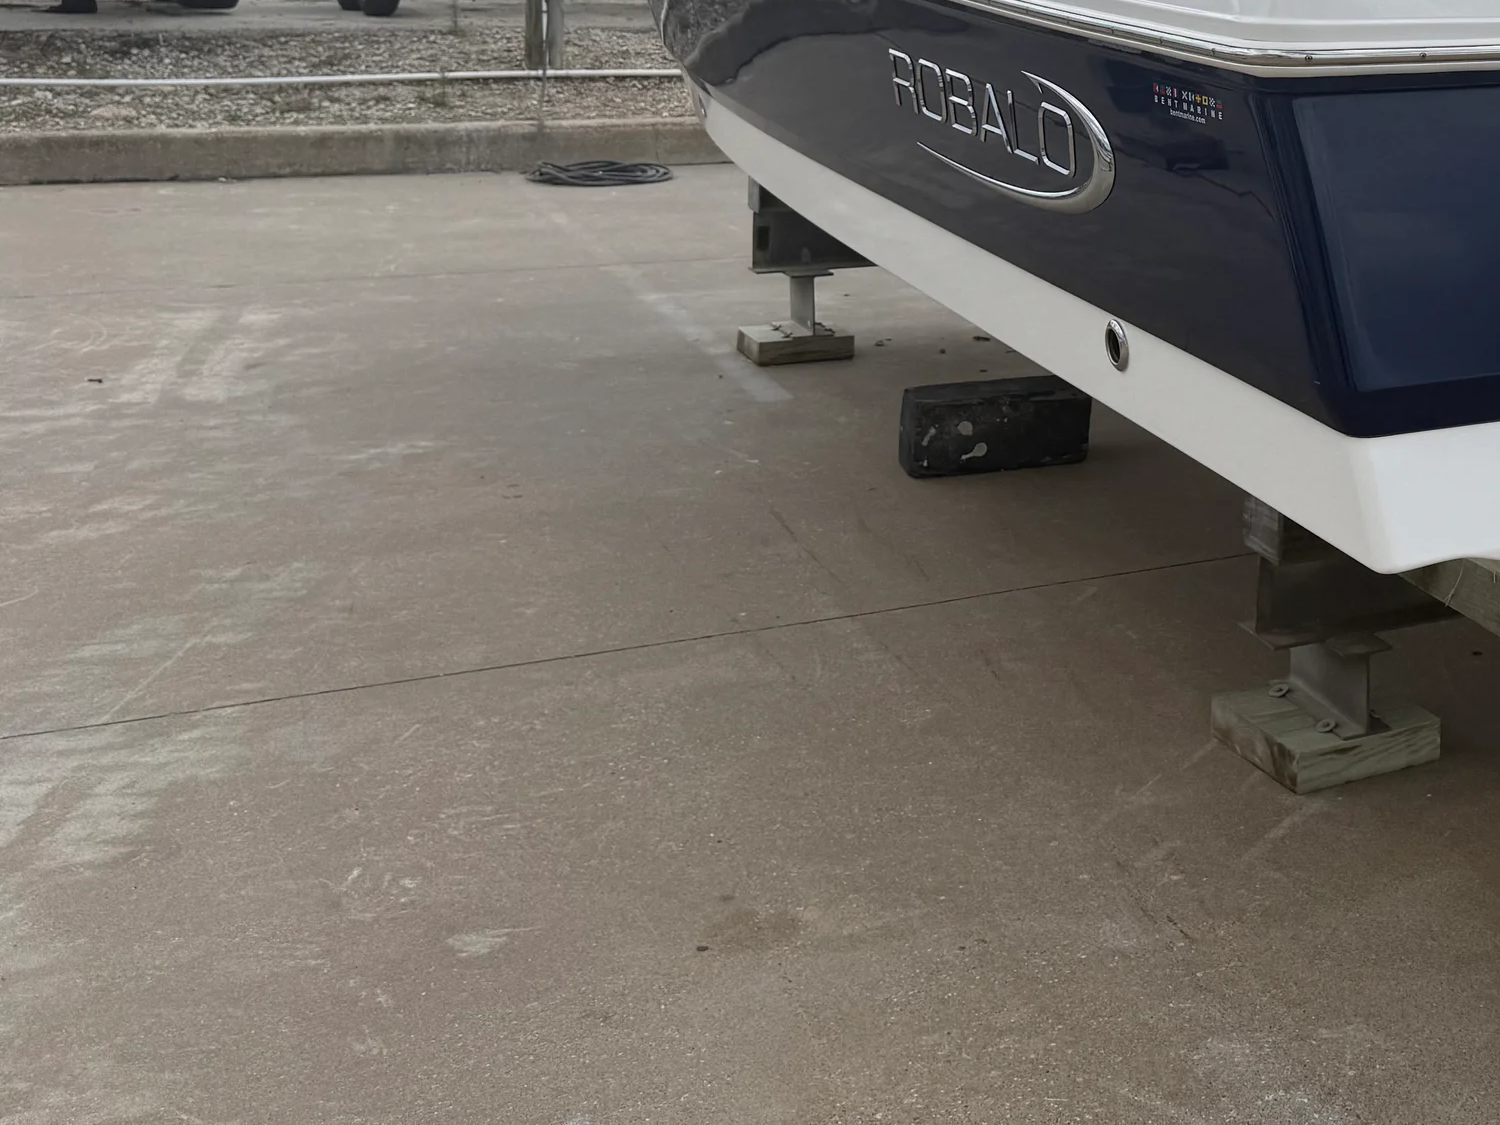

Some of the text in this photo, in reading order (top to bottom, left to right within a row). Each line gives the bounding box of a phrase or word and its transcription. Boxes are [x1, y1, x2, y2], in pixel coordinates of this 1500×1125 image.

[888, 47, 1076, 179] ROBALO
[1154, 95, 1223, 120] BENT MARINE
